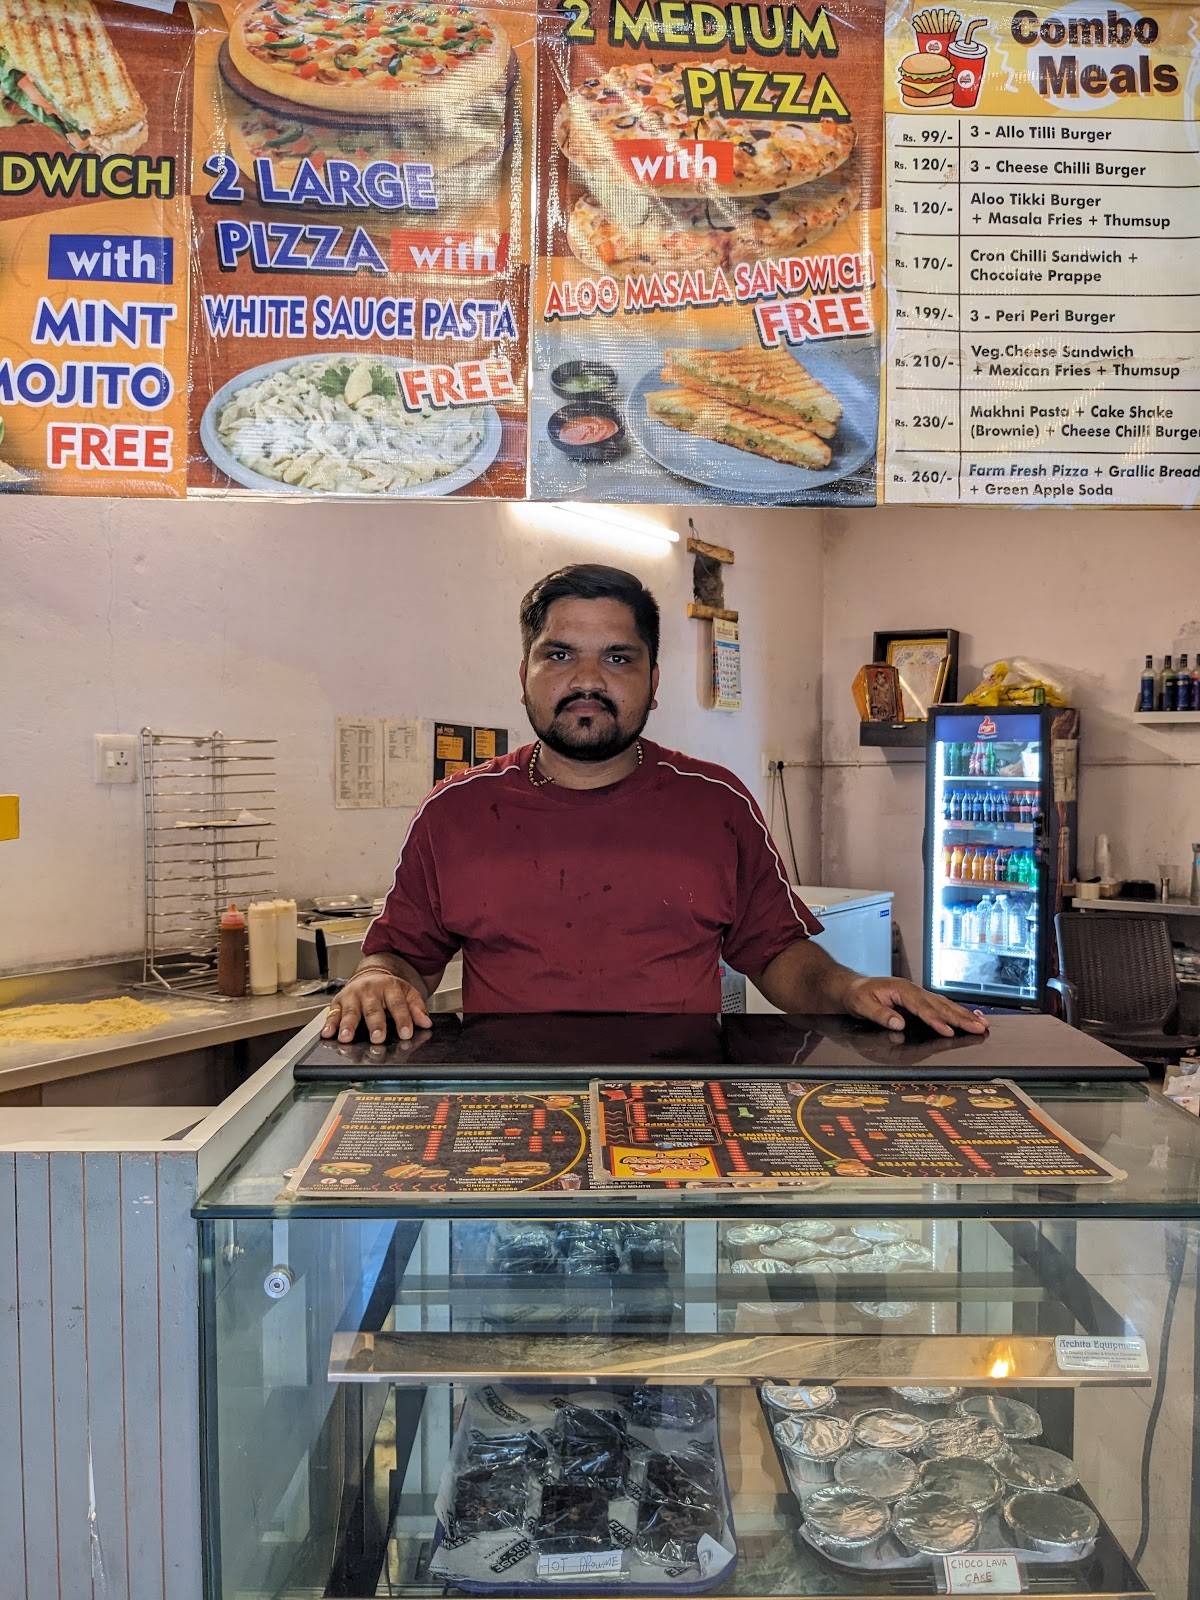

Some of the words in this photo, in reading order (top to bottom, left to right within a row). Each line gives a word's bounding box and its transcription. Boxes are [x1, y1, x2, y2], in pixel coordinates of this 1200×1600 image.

[563, 0, 596, 38] 2
[612, 0, 838, 51] MEDIUM
[1011, 9, 1159, 47] Combo
[1038, 55, 1179, 97] Meals
[685, 69, 849, 117] PIZZA
[903, 133, 916, 143] Rs.
[921, 130, 953, 144] 99/-
[970, 126, 979, 138] 3
[995, 125, 1025, 139] Allo
[1029, 126, 1055, 140] Tilli
[1061, 128, 1112, 143] Burger
[630, 144, 718, 181] with
[894, 161, 907, 170] Rs.
[912, 157, 953, 171] 120/-
[970, 160, 979, 172] 3
[996, 160, 1049, 174] Cheese
[1054, 161, 1090, 175] Chilli
[1095, 162, 1146, 178] Burger
[2, 155, 171, 197] DWICH
[206, 155, 245, 201] 2
[256, 157, 439, 210] LARGE
[894, 204, 907, 213] Rs.
[912, 200, 953, 214] 120/-
[970, 192, 1005, 206] Aloo
[1010, 192, 1046, 206] Tikki
[1051, 194, 1102, 210] Burger
[972, 214, 982, 224] +
[988, 212, 1042, 226] Masala
[1048, 213, 1083, 226] Fries
[1088, 215, 1098, 226] +
[1104, 214, 1170, 230] Thumsup
[216, 220, 389, 273] PIZZA
[408, 235, 497, 272] with
[66, 239, 156, 279] with
[895, 260, 908, 268] Rs.
[913, 256, 953, 271] 170/-
[970, 250, 1005, 262] Cron
[1010, 250, 1047, 263] Chilli
[1052, 250, 1122, 264] Sandwich
[1128, 252, 1138, 263] +
[545, 275, 619, 316] ALOO
[625, 269, 730, 309] MASALA
[734, 252, 875, 298] SANDWICH
[1048, 269, 1102, 286] Prappe
[204, 297, 305, 337] WHITE
[314, 298, 413, 338] SAUCE
[423, 298, 518, 340] PASTA
[759, 296, 870, 343] FREE
[896, 310, 909, 318] Rs.
[914, 306, 953, 320] 199/-
[970, 310, 979, 322] 3
[996, 310, 1025, 323] Peri
[1030, 310, 1059, 323] Peri
[1065, 310, 1116, 326] Burger
[35, 300, 174, 346] MINT
[1062, 345, 1134, 358] Sandwich
[895, 358, 908, 368] Rs.
[912, 355, 954, 369] 210/-
[973, 366, 983, 376] +
[988, 364, 1050, 377] Mexican
[1055, 364, 1091, 377] Fries
[1096, 366, 1107, 376] +
[1112, 364, 1180, 380] Thumsup
[400, 360, 514, 408] FREE
[970, 406, 1025, 418] Makhni
[1030, 406, 1070, 418] Pasta
[1075, 407, 1085, 417] +
[1090, 405, 1125, 418] Cake
[1129, 406, 1174, 419] Shake
[894, 419, 908, 428] Rs.
[912, 416, 954, 429] 230/-
[970, 424, 1040, 440] (Brownie)
[1046, 426, 1055, 436] +
[1061, 424, 1111, 438] Cheese
[1115, 425, 1150, 438] Chilli
[1155, 426, 1200, 441] Burger
[50, 425, 170, 468] FREE
[893, 474, 907, 483] Rs.
[912, 471, 952, 484] 260/-
[969, 464, 1005, 477] Farm
[1010, 464, 1047, 477] Fresh
[1052, 464, 1089, 478] Pizza
[1094, 466, 1103, 477] +
[1108, 464, 1154, 478] Grallic
[1160, 465, 1200, 478] Bread
[970, 485, 979, 494] +
[985, 484, 1028, 496] Green
[1033, 484, 1074, 499] Apple
[1079, 484, 1113, 496] Soda
[538, 1557, 568, 1576] HOT
[950, 1559, 983, 1569] CHOCO
[986, 1559, 1008, 1569] LAVA
[964, 1571, 993, 1583] CAKE
